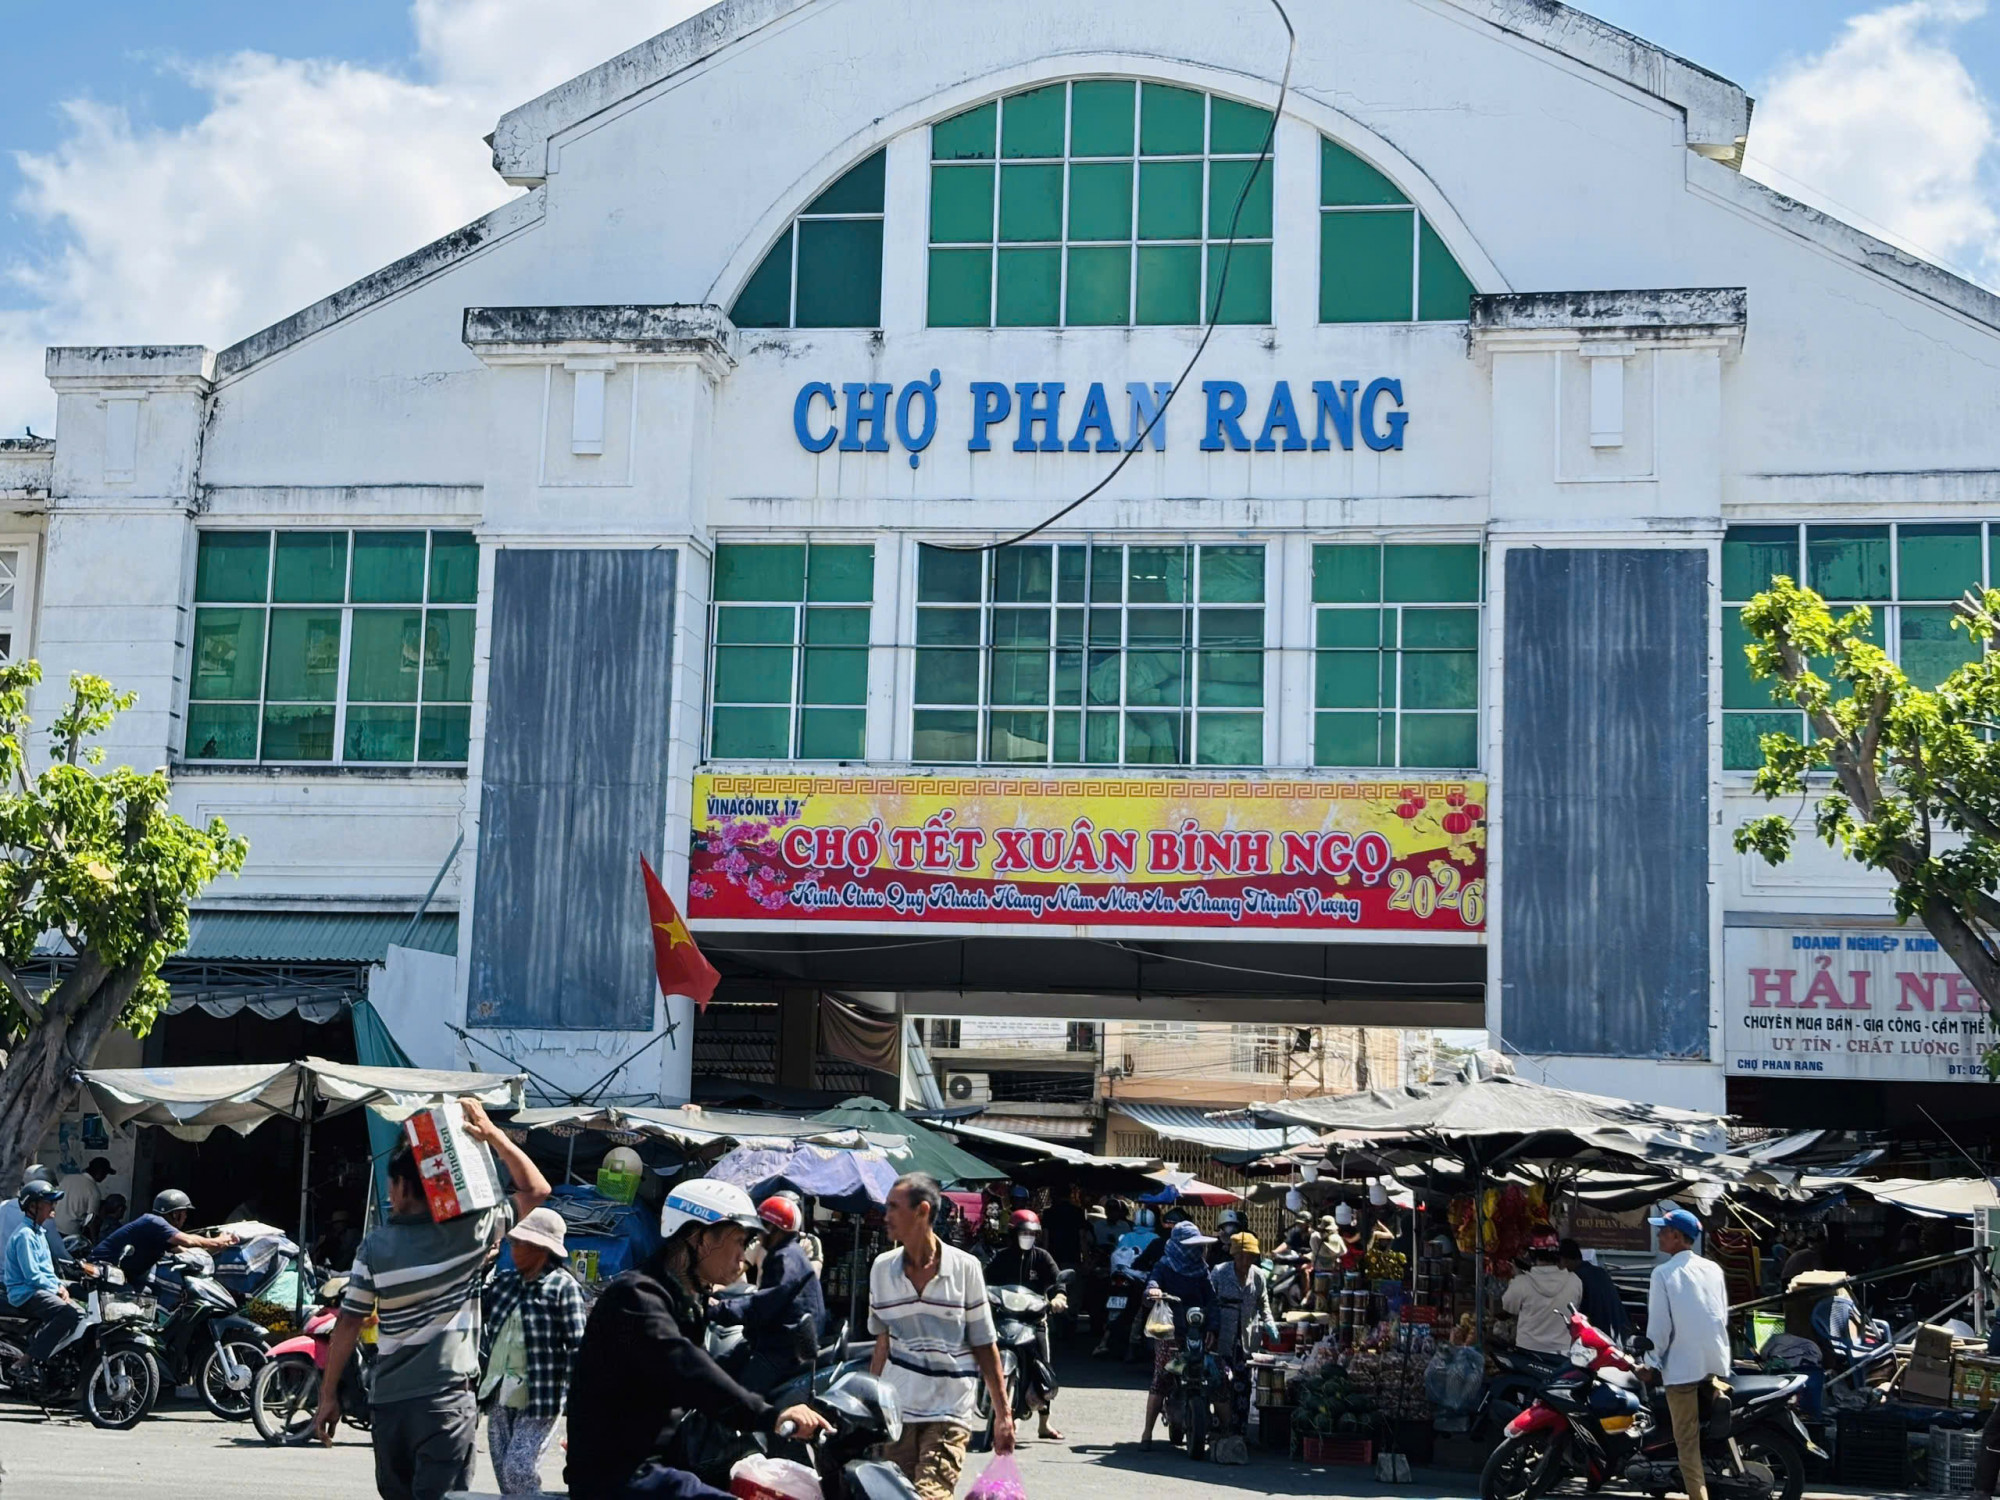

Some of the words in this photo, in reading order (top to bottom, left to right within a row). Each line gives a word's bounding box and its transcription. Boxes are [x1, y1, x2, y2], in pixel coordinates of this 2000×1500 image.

[794, 368, 941, 469] CHỢ
[968, 382, 1172, 452] PHAN
[1199, 377, 1409, 452] RANG
[707, 798, 779, 816] VINACONEX
[784, 800, 799, 816] 17
[783, 818, 882, 876] CHỢ
[890, 809, 985, 870] TẾT
[993, 818, 1139, 873] XUÂN
[1148, 819, 1272, 875] BÍNH
[1281, 832, 1390, 884] NGỌ
[843, 882, 884, 907] Chúc
[887, 882, 925, 915] Quý
[929, 882, 988, 909] Khách
[992, 884, 1042, 918] Hàng
[1046, 884, 1094, 911] Năm
[1098, 886, 1140, 912] Mới
[1142, 887, 1174, 912] An
[1178, 886, 1241, 921] Khang
[1243, 887, 1299, 918] Thịnh
[1297, 888, 1360, 922] Vượng
[1388, 867, 1485, 926] 2026
[1792, 936, 1841, 950] DOANH
[1846, 935, 1899, 954] NGHIỆP
[1905, 937, 1938, 952] KINH
[1748, 955, 1872, 1010] HẢI
[1744, 1014, 1791, 1030] CHUYÊN
[1796, 1017, 1822, 1031] MUA
[1826, 1015, 1852, 1031] BÁN
[1863, 1018, 1883, 1033] GIA
[1888, 1017, 1921, 1033] CÔNG
[1932, 1017, 1958, 1034] CẦM
[1772, 1037, 1795, 1051] UY
[1802, 1035, 1831, 1051] TÍN
[1846, 1036, 1894, 1053] CHẤT
[1737, 1058, 1758, 1071] CHỢ
[1762, 1060, 1791, 1071] PHAN
[1794, 1061, 1824, 1071] RANG
[441, 1127, 466, 1191] Heineken
[679, 1199, 694, 1212] PV
[694, 1206, 712, 1219] OIL
